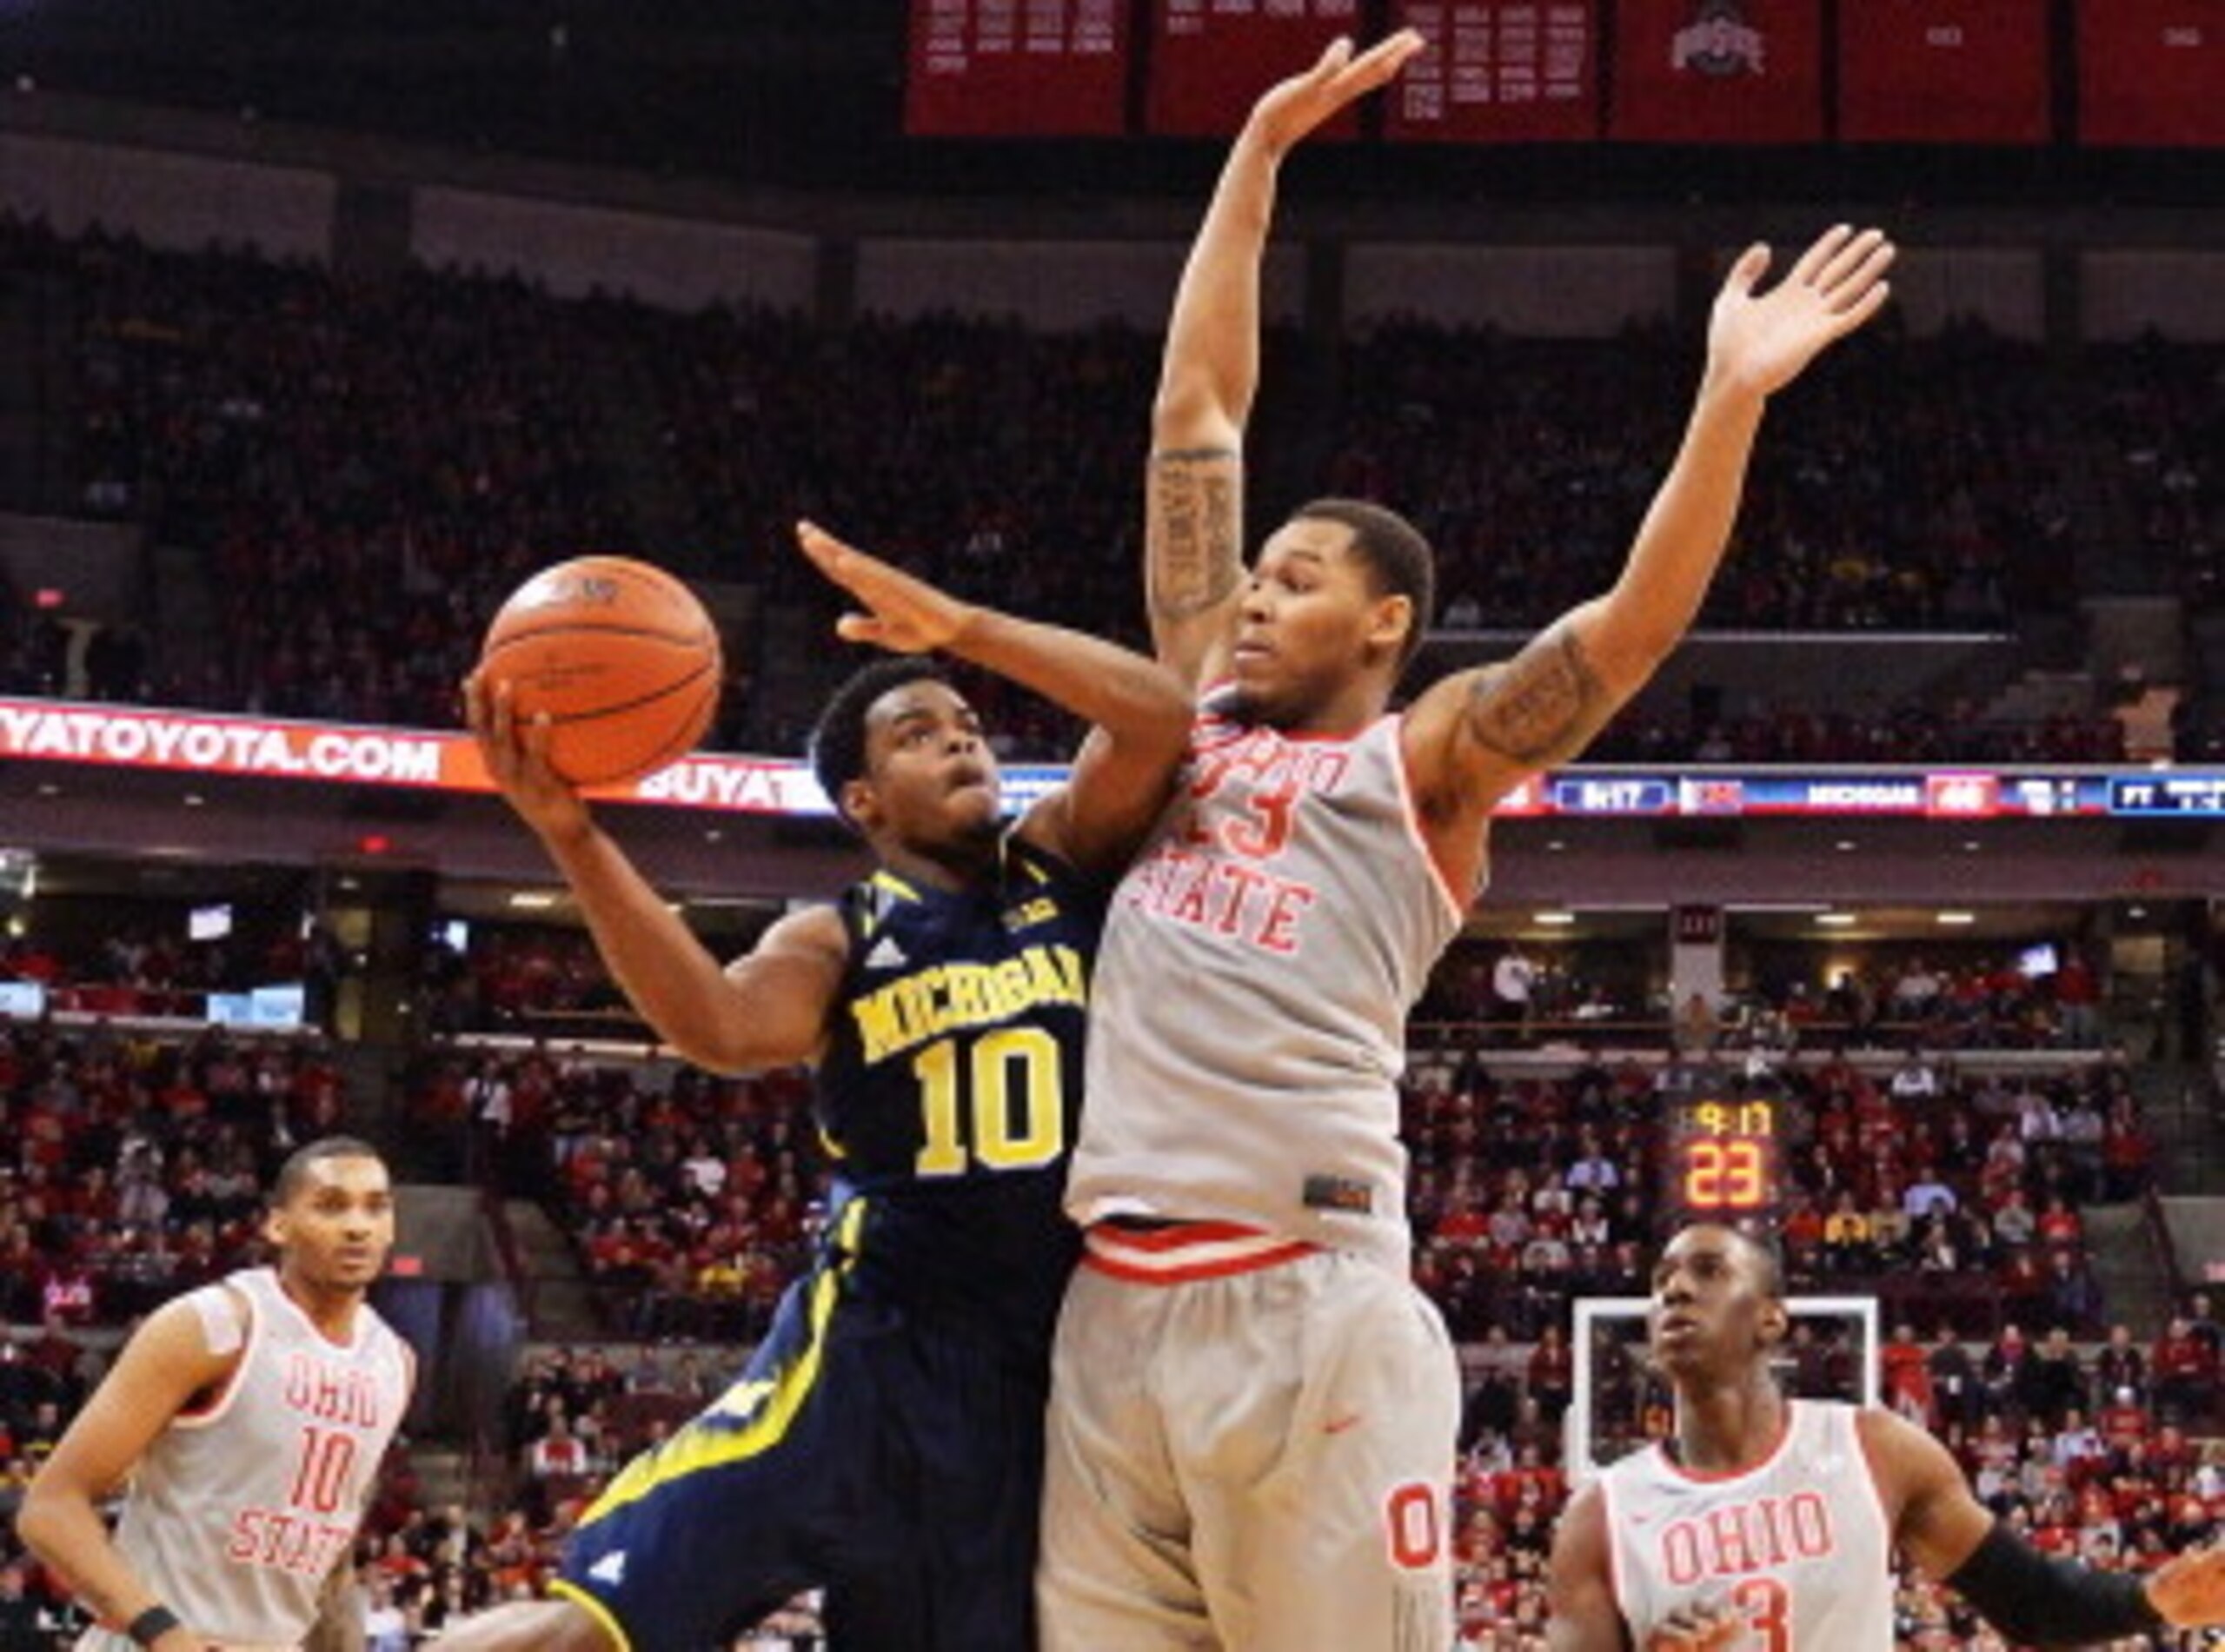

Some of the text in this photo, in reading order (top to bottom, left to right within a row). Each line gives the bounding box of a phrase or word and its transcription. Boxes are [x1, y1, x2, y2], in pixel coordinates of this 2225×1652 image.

[913, 1027, 1063, 1176] 10
[1684, 1141, 1763, 1206] 23
[283, 1352, 379, 1429] OHIO
[289, 1425, 355, 1514] 10
[1662, 1490, 1833, 1587] OHIO
[1731, 1576, 1790, 1652] 3
